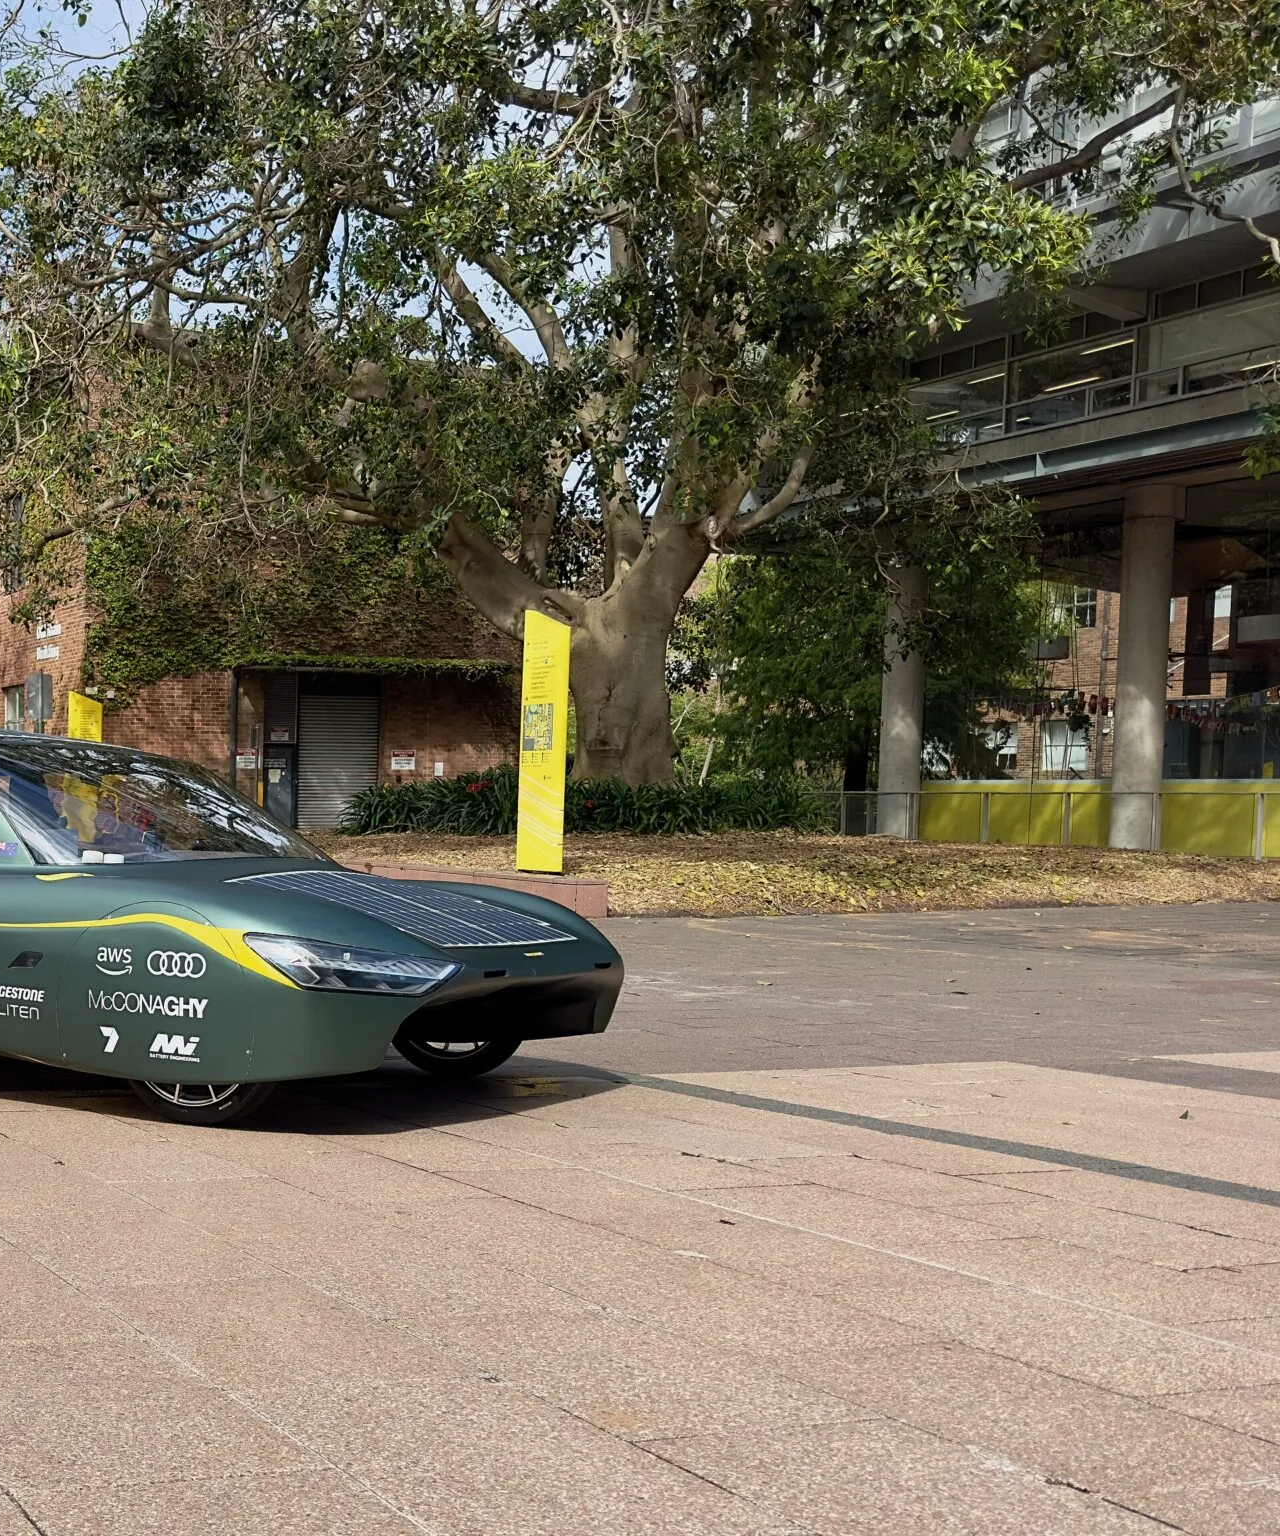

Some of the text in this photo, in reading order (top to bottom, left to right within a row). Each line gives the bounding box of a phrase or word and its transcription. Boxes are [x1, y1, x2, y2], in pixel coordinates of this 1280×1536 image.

[97, 946, 132, 964] aws
[88, 988, 209, 1019] McCONAGHY
[149, 1052, 201, 1063] BATTERY ENGINEERING
